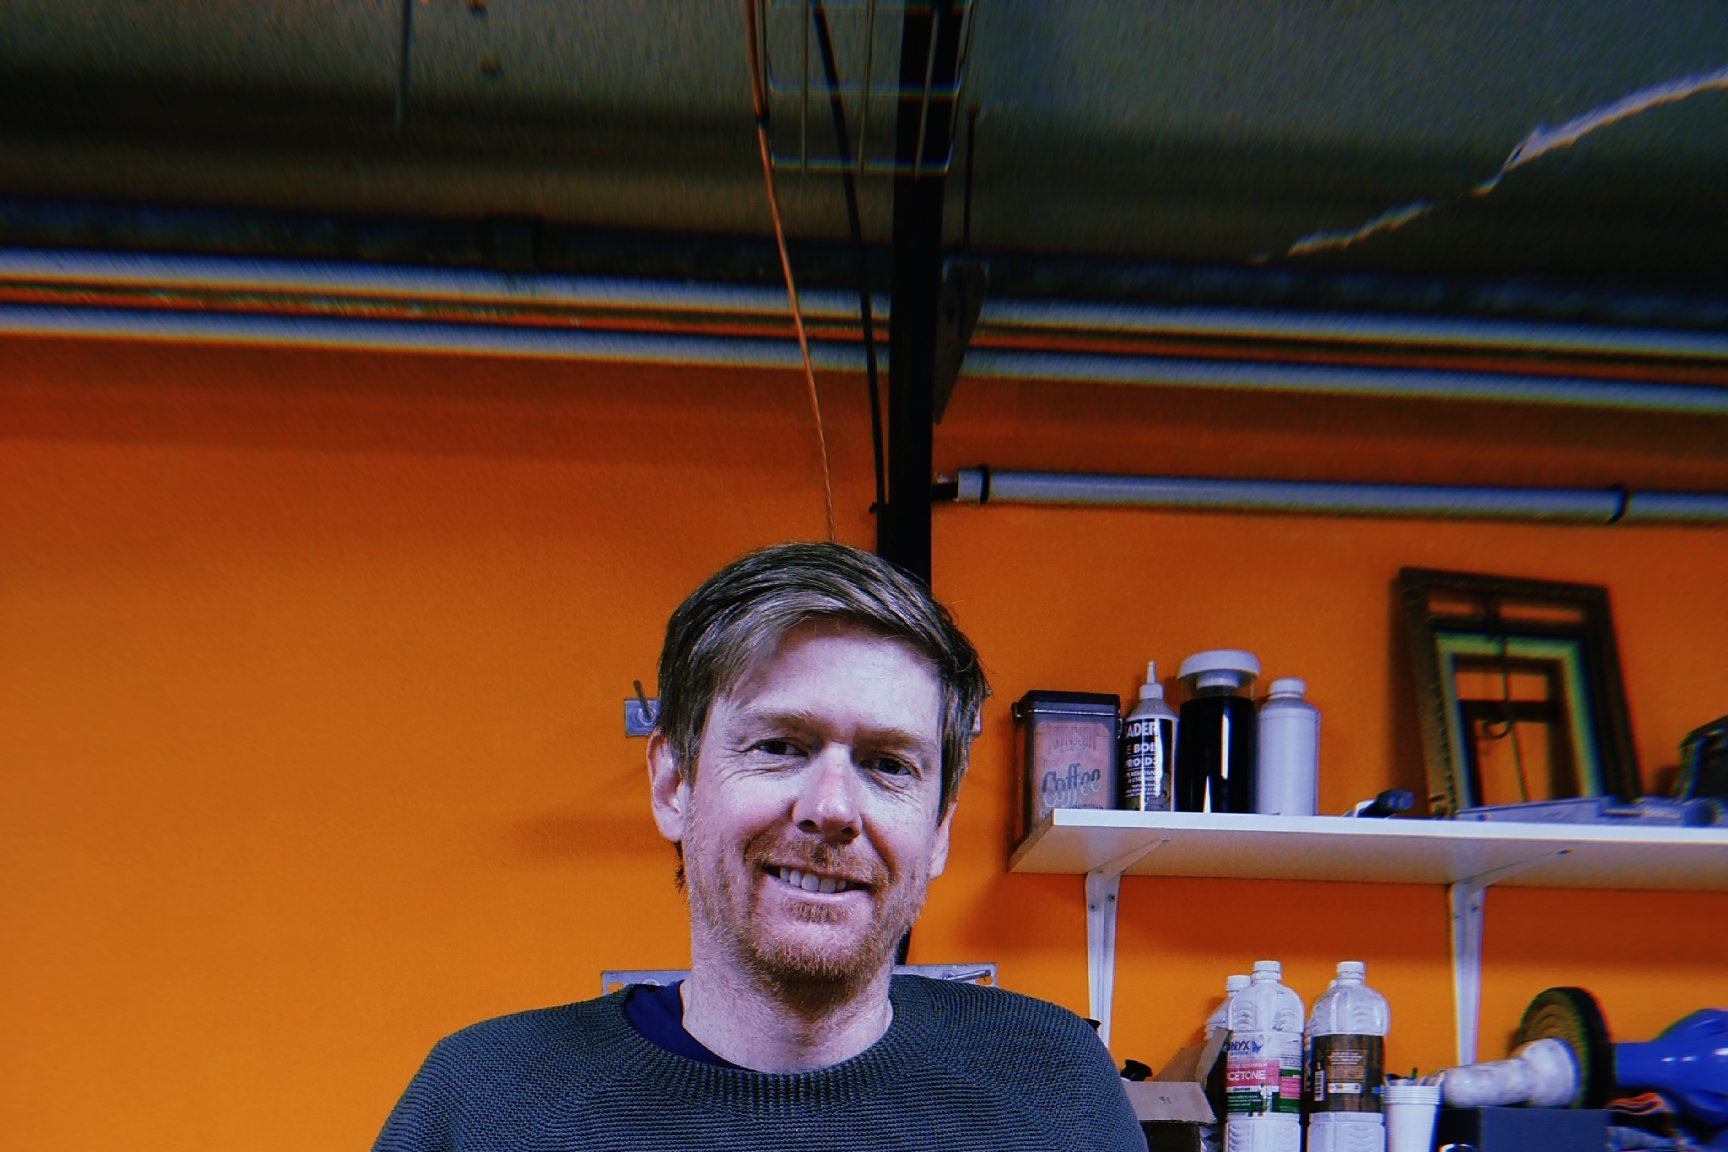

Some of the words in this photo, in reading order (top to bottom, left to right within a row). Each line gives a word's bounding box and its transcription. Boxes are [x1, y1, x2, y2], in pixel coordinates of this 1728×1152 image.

[1125, 721, 1155, 738] ADER
[1041, 762, 1101, 807] Coffee
[1227, 1069, 1267, 1081] CÉTONE
